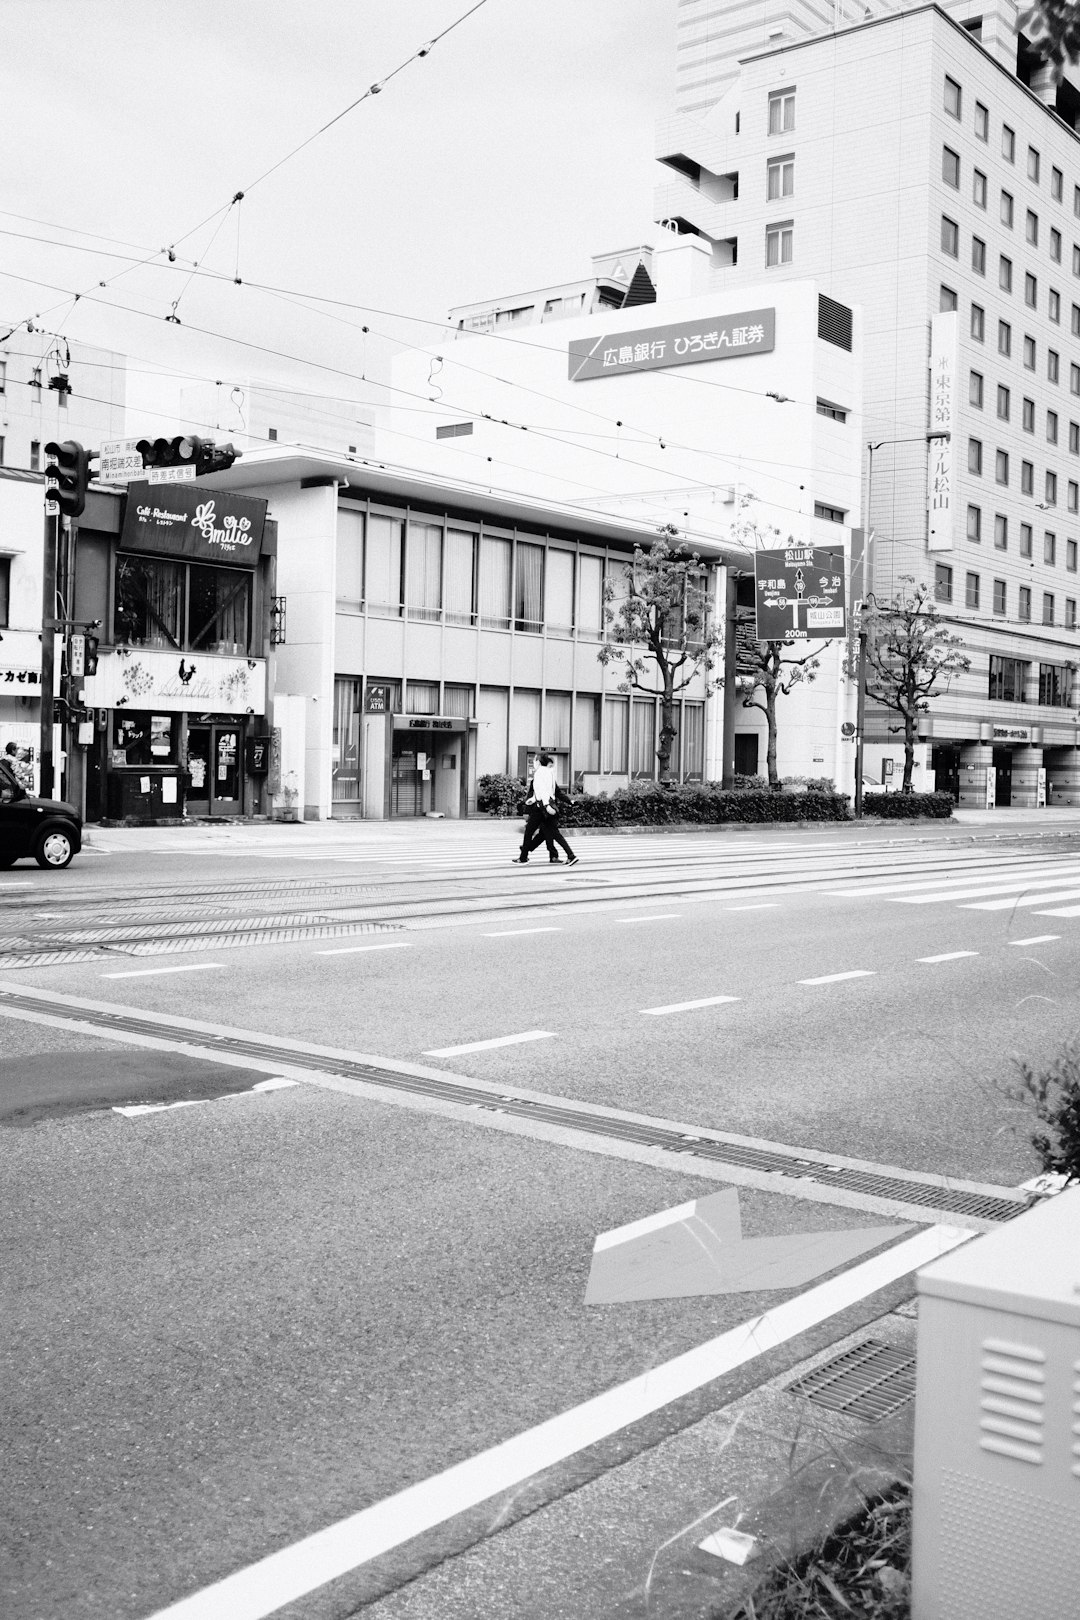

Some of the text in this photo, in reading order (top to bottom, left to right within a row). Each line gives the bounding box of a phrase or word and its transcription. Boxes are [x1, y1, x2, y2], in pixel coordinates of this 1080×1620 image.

[602, 324, 765, 367] 広島銀行 ひろぎん証券
[151, 468, 193, 481] 時差式信号
[784, 549, 814, 560] 松山駅
[758, 579, 786, 590] 宇和島
[819, 576, 841, 588] 今治
[784, 629, 807, 638] 200m
[0, 670, 42, 684] カゼ商
